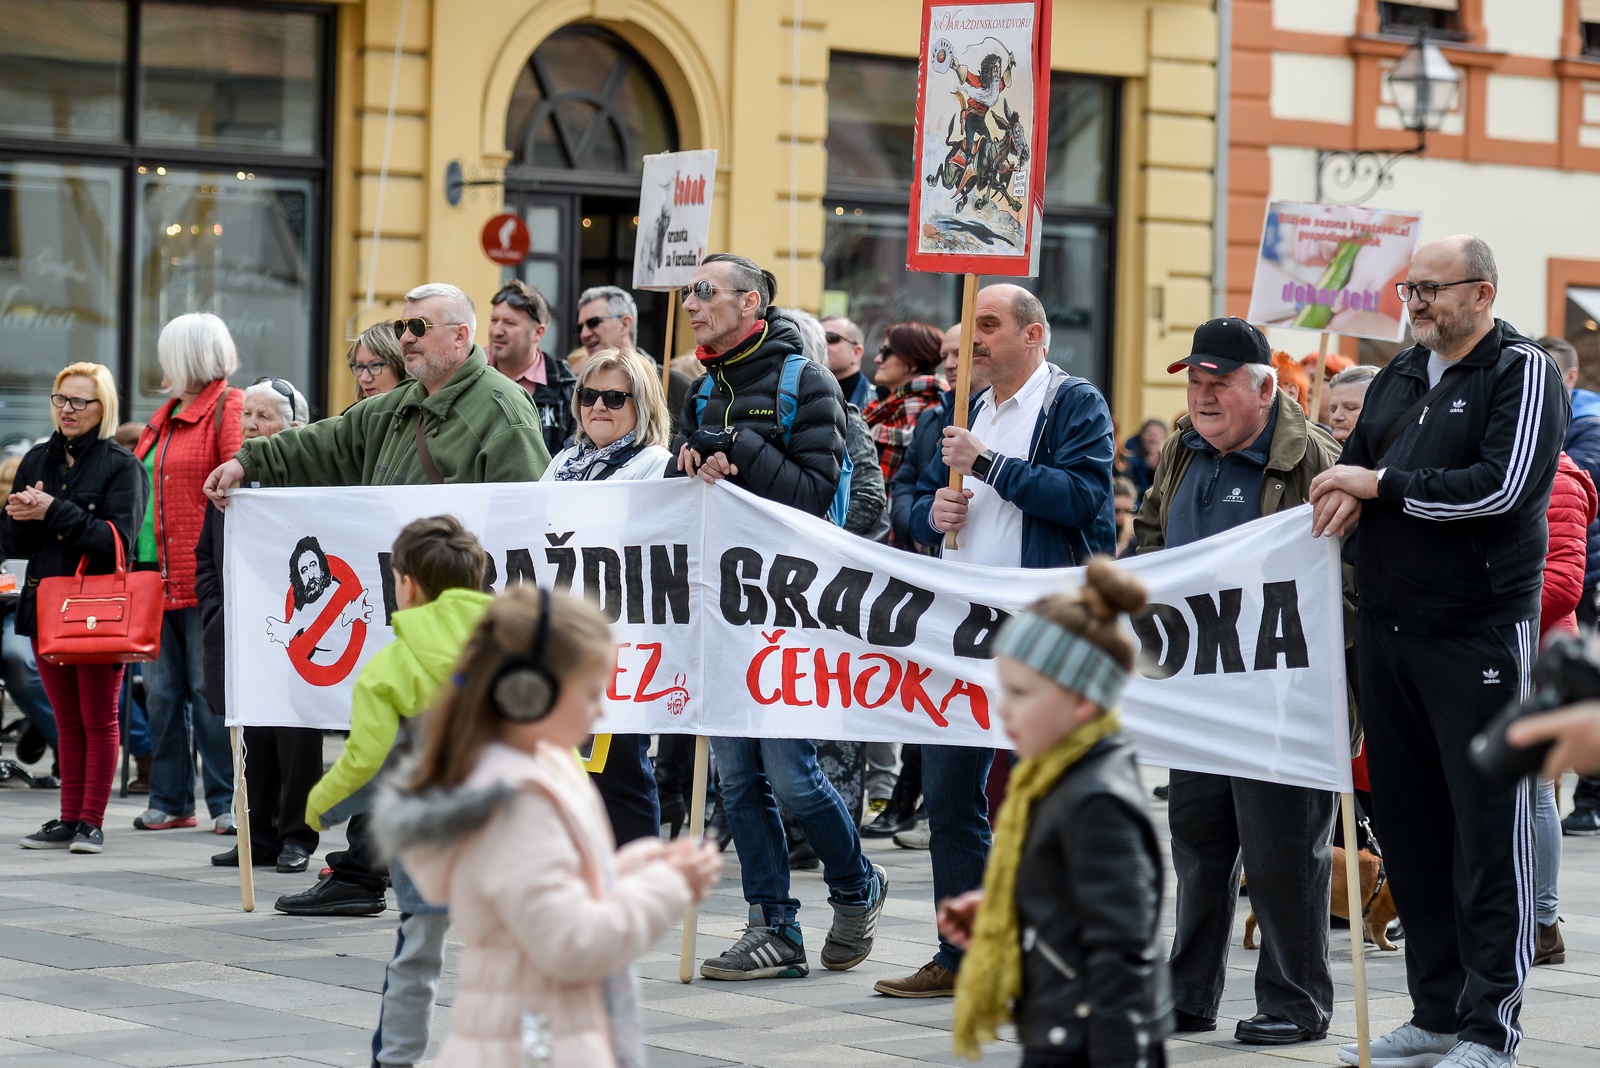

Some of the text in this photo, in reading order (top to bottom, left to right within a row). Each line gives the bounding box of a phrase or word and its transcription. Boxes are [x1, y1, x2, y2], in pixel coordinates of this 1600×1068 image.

[932, 9, 1031, 31] NA VARAŽDINSKOM DVORU
[1314, 218, 1347, 230] sezona
[1281, 281, 1381, 312] dobar tek!
[719, 546, 935, 647] GRAD
[953, 580, 1309, 680] BOKA
[606, 629, 990, 731] EZ ČEHOKA
